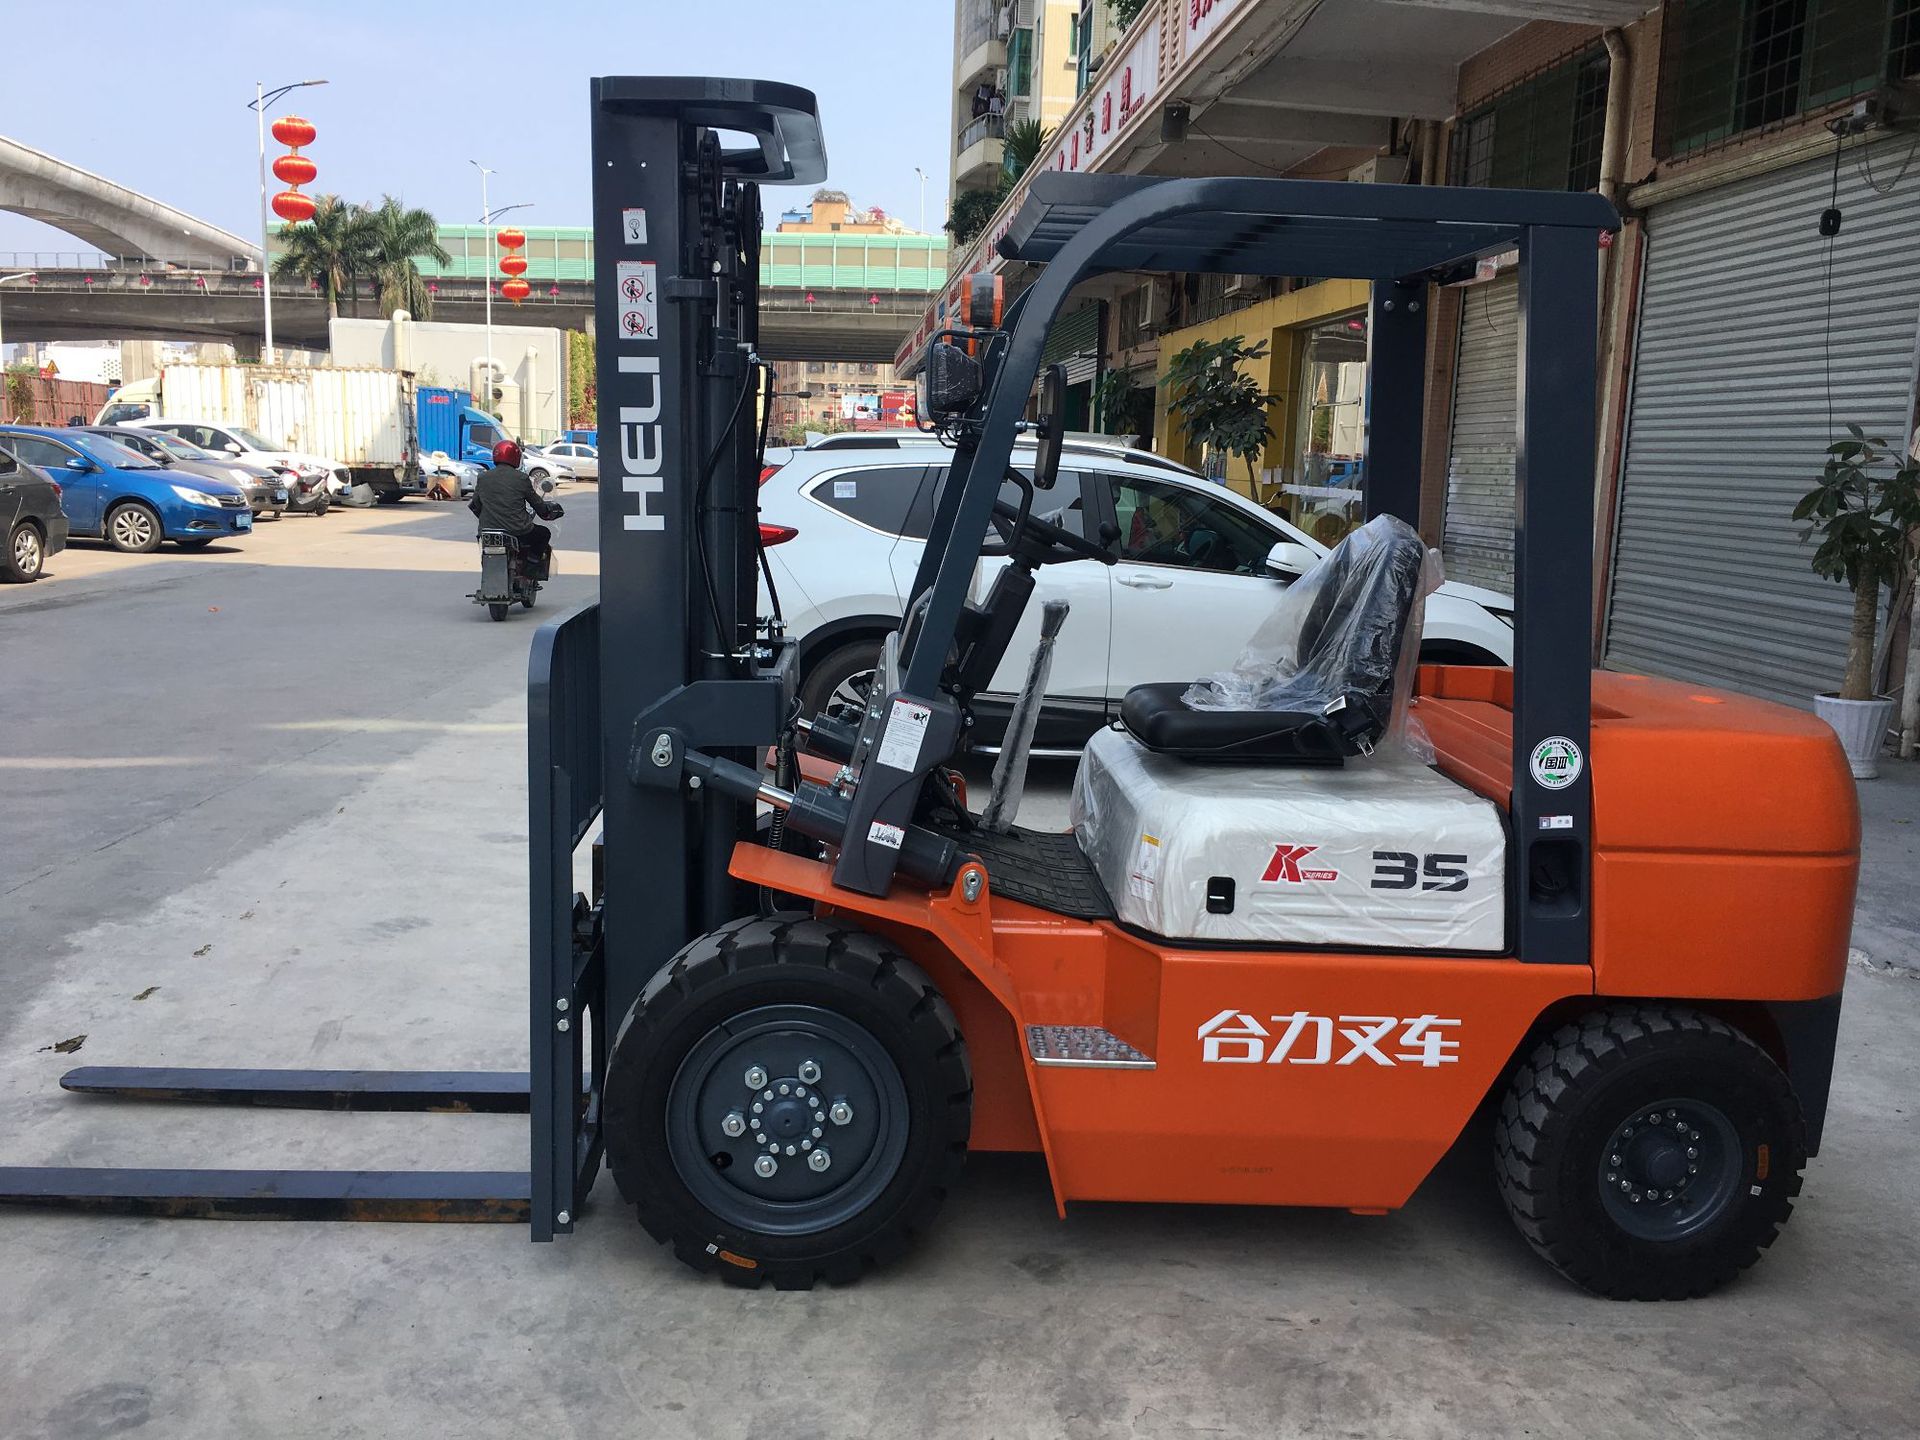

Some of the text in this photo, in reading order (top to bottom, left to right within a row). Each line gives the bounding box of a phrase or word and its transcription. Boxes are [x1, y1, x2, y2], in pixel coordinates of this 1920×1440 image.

[618, 356, 665, 531] HELI
[1260, 844, 1334, 883] K SERIES
[1370, 850, 1470, 893] 35
[1197, 1009, 1462, 1068] 合力叉车
